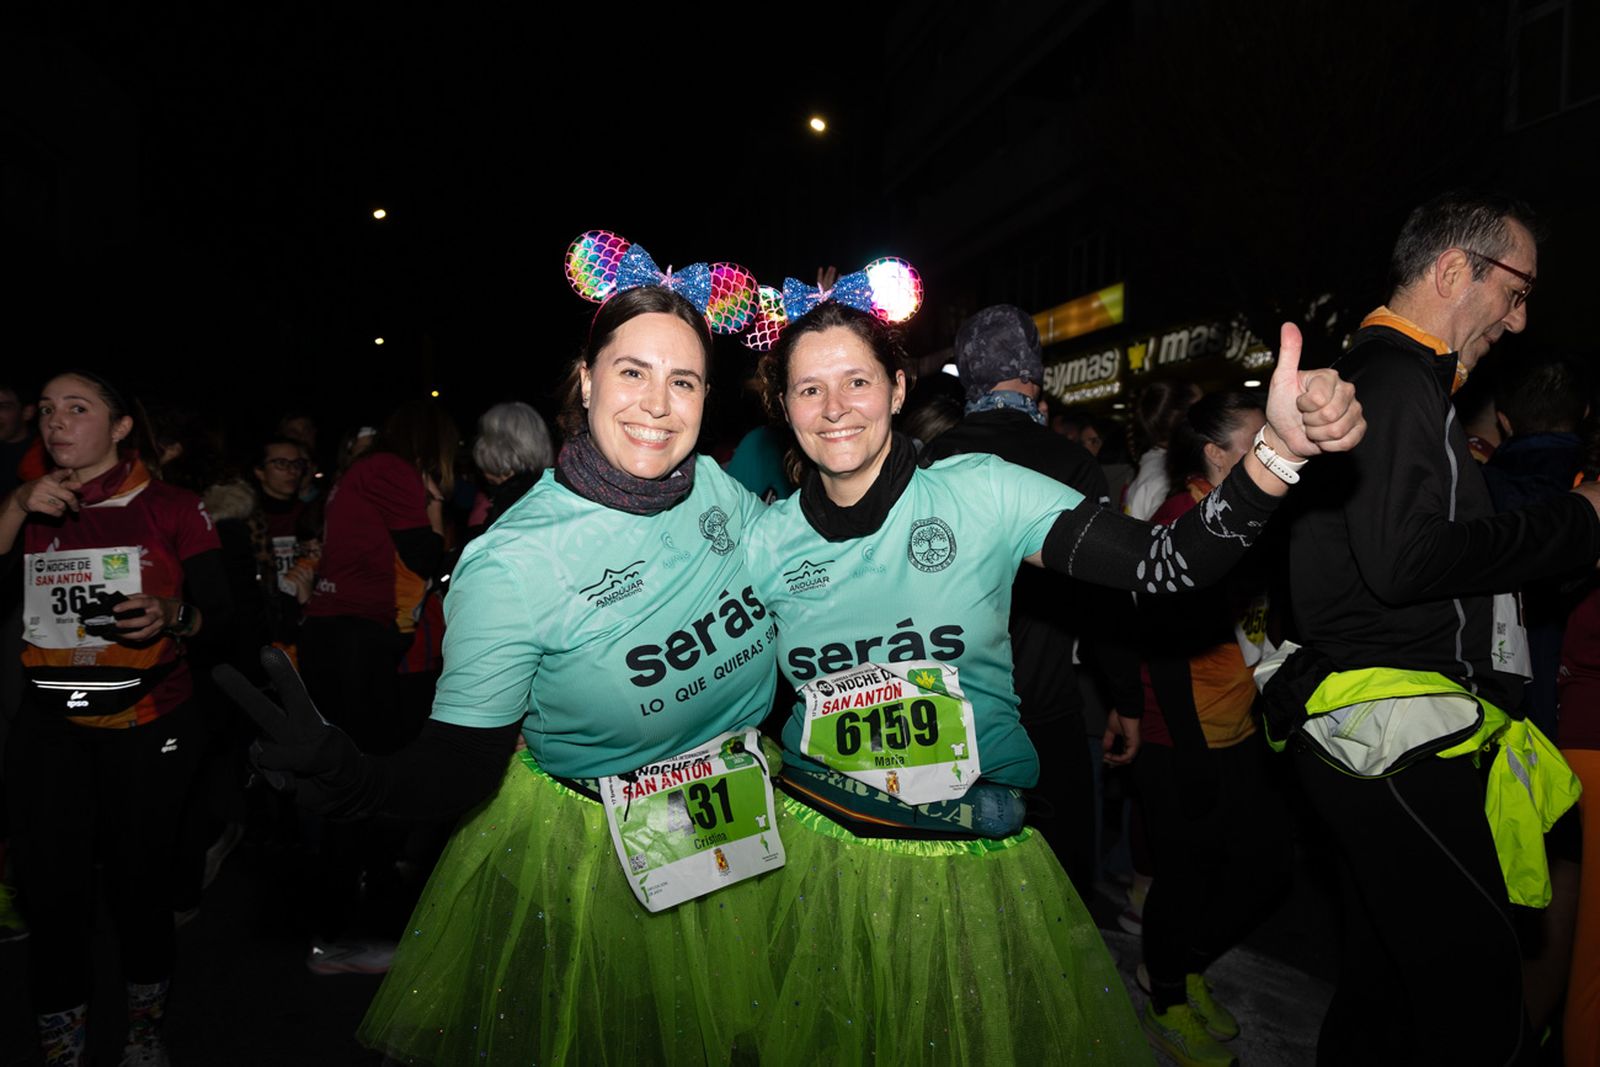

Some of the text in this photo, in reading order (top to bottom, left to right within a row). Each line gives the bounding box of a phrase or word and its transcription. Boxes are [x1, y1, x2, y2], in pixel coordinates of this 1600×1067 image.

[1042, 350, 1116, 399] symas
[35, 575, 55, 586] SAN
[47, 562, 75, 573] NOCHE
[77, 561, 91, 571] DE
[596, 579, 644, 607] ANDÚJAR
[625, 585, 766, 687] serás
[788, 617, 965, 680] serás
[640, 698, 665, 717] LO
[675, 677, 707, 703] QUE
[714, 639, 764, 680] QUIERAS
[836, 671, 881, 693] NOCHE
[822, 681, 903, 715] SAN ANTÓN
[836, 699, 939, 756] 6159
[637, 759, 691, 776] NOCHE
[623, 776, 658, 800] SAN
[694, 833, 728, 850] Cristina
